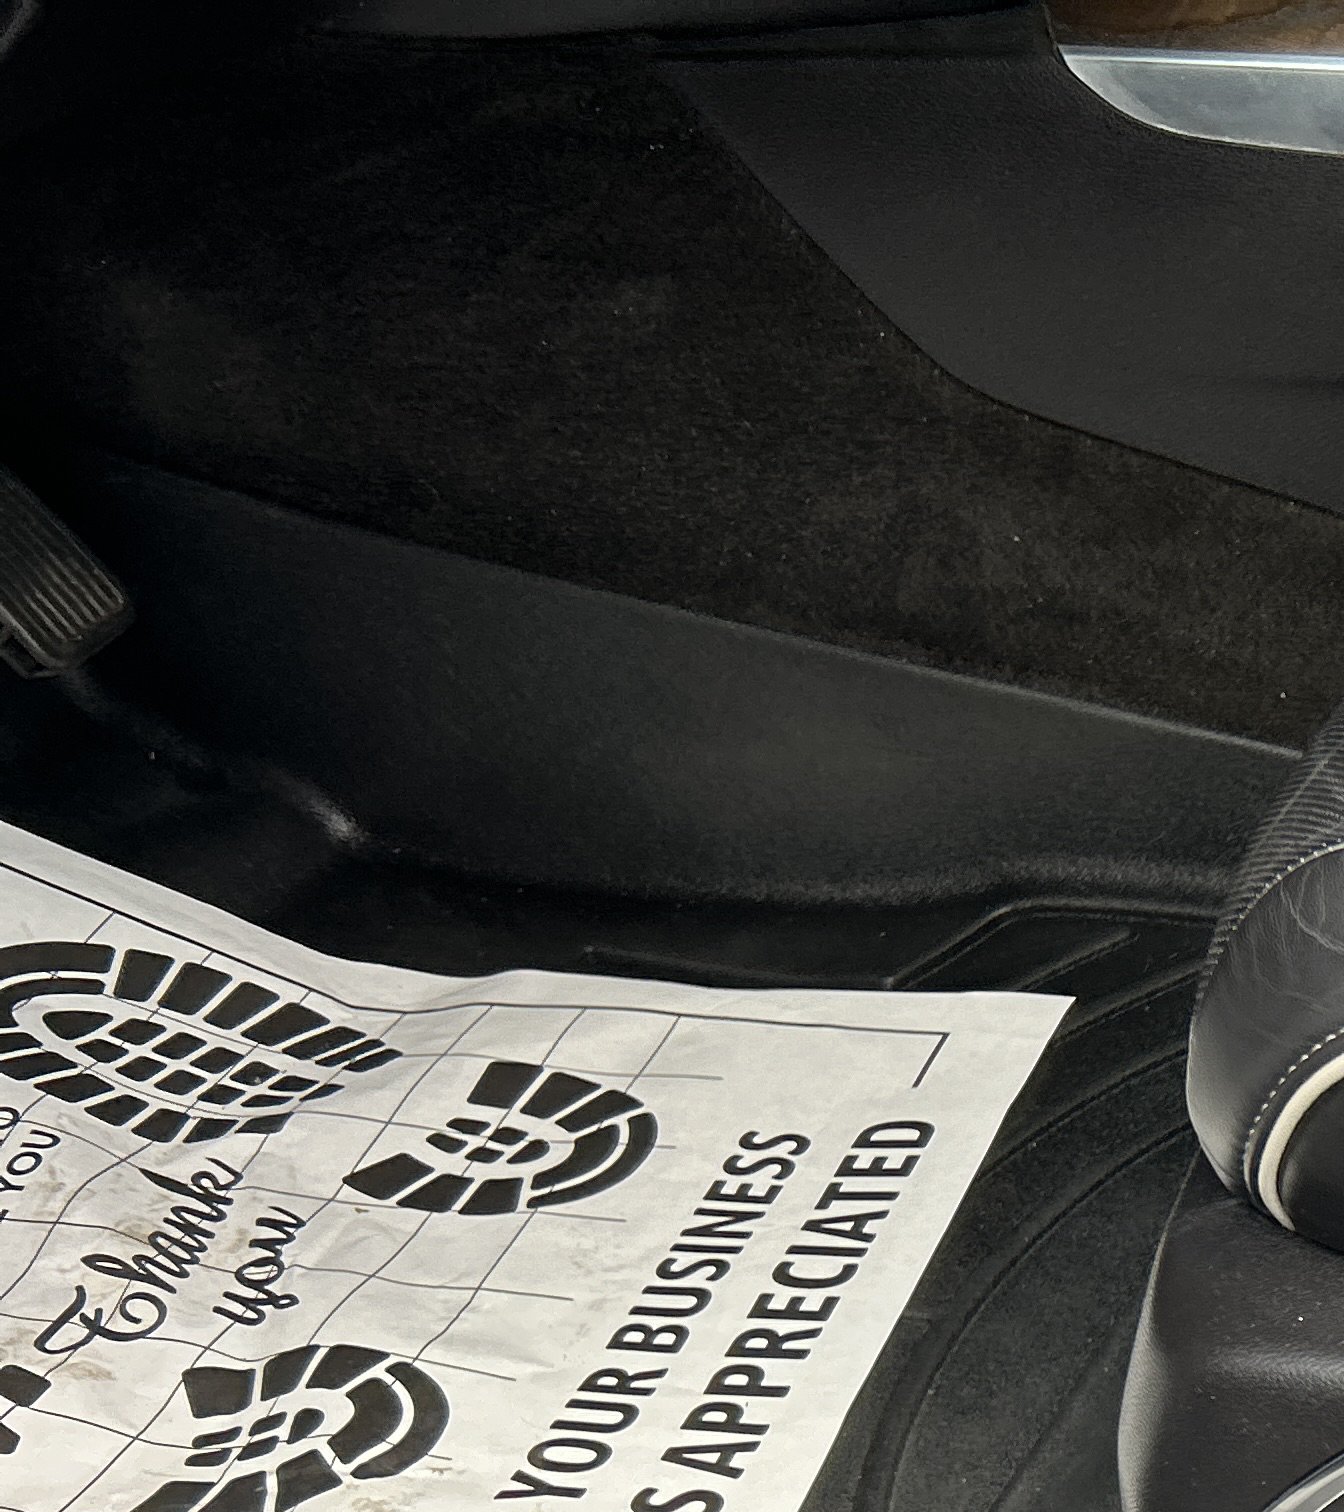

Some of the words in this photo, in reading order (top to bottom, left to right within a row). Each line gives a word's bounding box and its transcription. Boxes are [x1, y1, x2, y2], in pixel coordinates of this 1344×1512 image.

[34, 1158, 245, 1355] Thank
[213, 1206, 307, 1326] you
[494, 1368, 669, 1499] YOUR
[605, 1130, 811, 1354] BUSINESS
[660, 1120, 936, 1480] APPRECIATED
